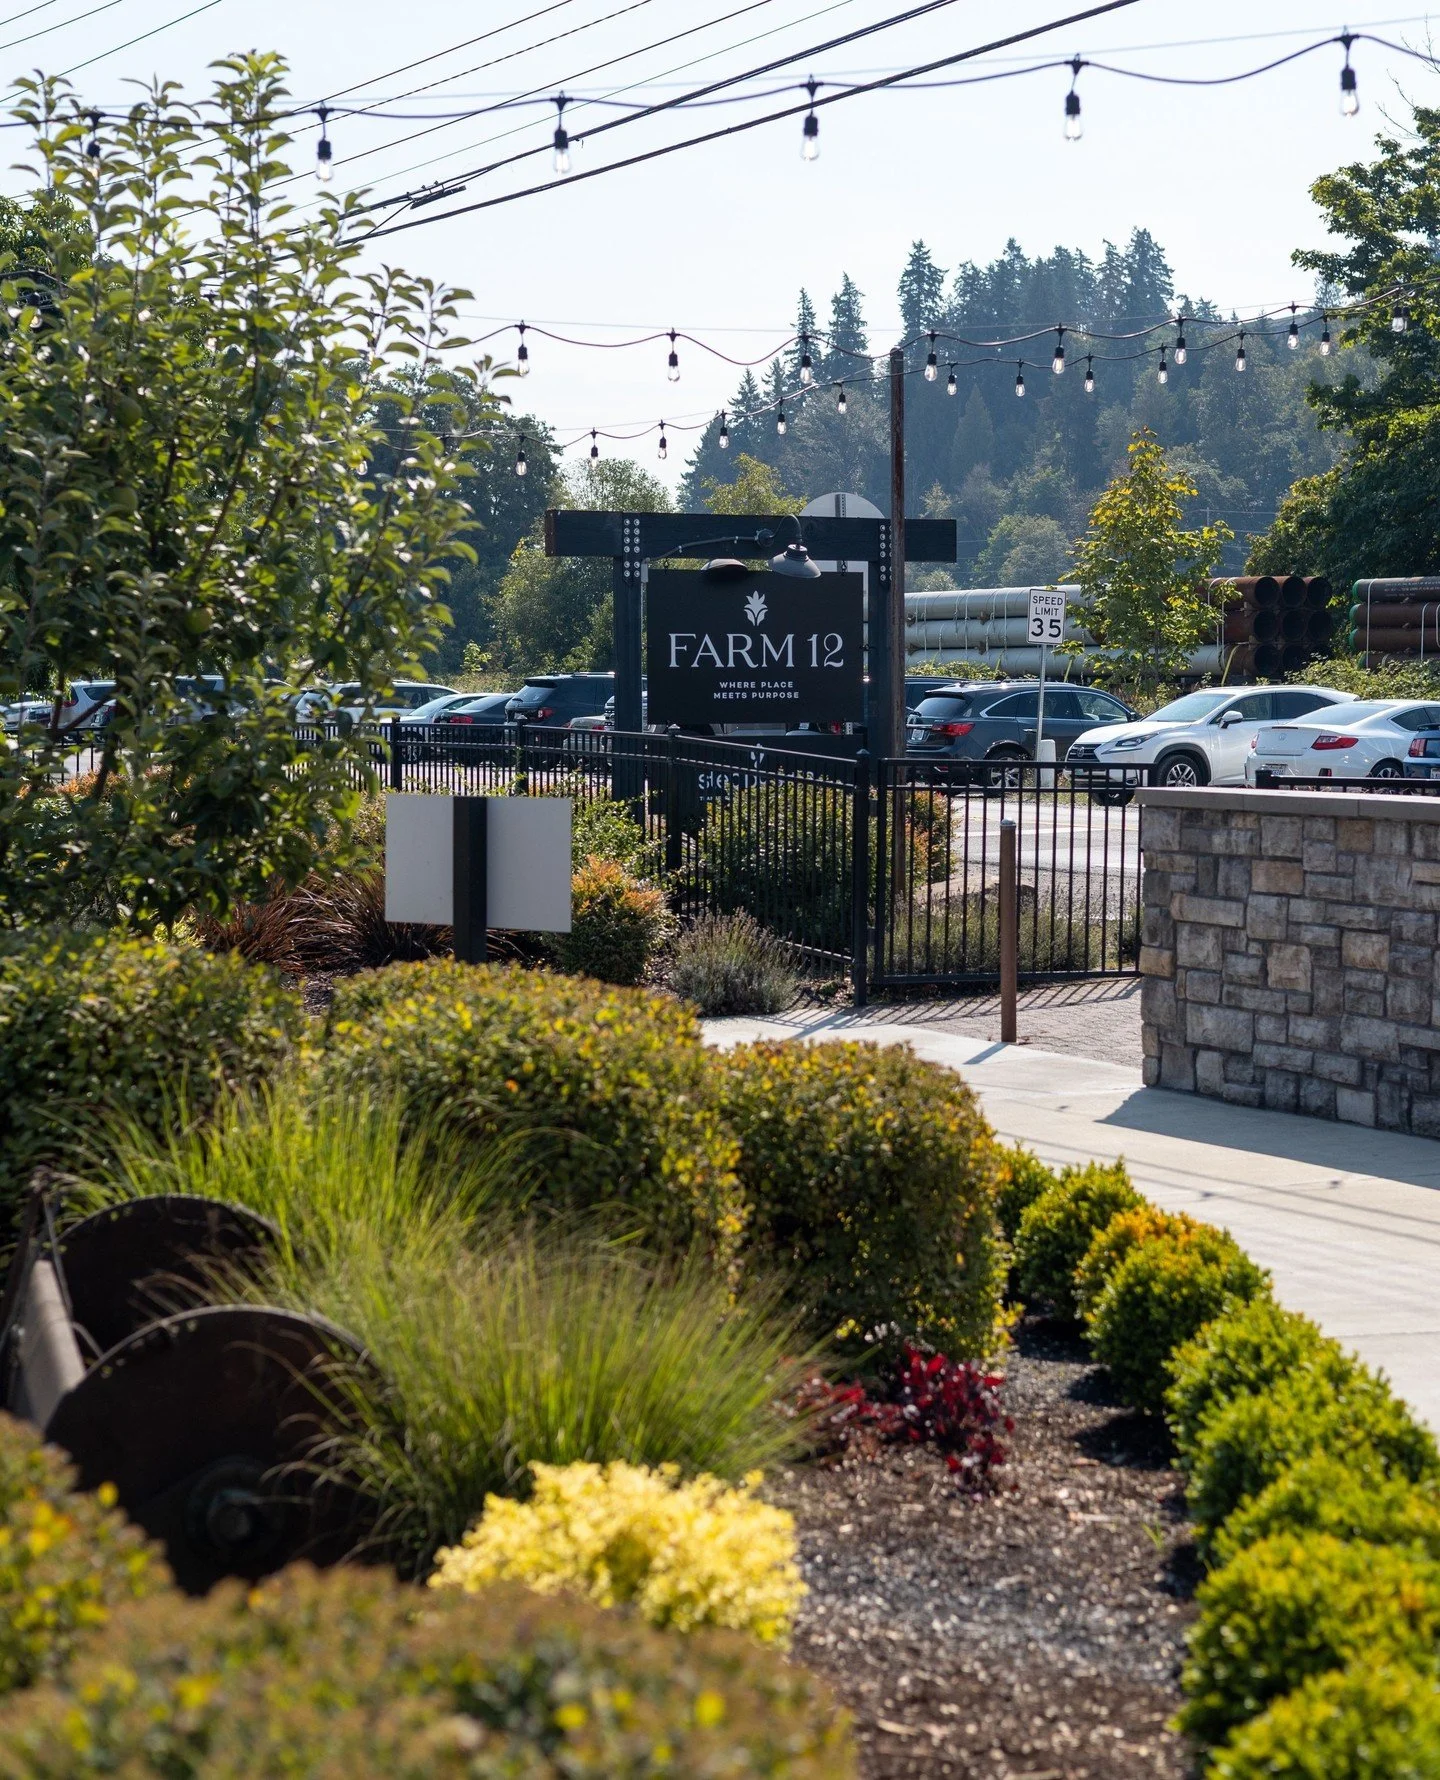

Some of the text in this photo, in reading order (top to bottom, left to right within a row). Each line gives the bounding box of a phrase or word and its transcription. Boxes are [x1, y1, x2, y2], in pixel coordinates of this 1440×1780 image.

[1032, 595, 1063, 605] SPEED
[1035, 607, 1059, 616] LIMIT
[1031, 617, 1061, 638] 35
[668, 632, 844, 668] FARM 12
[719, 681, 756, 689] WHERE
[751, 691, 799, 699] PURPOSE
